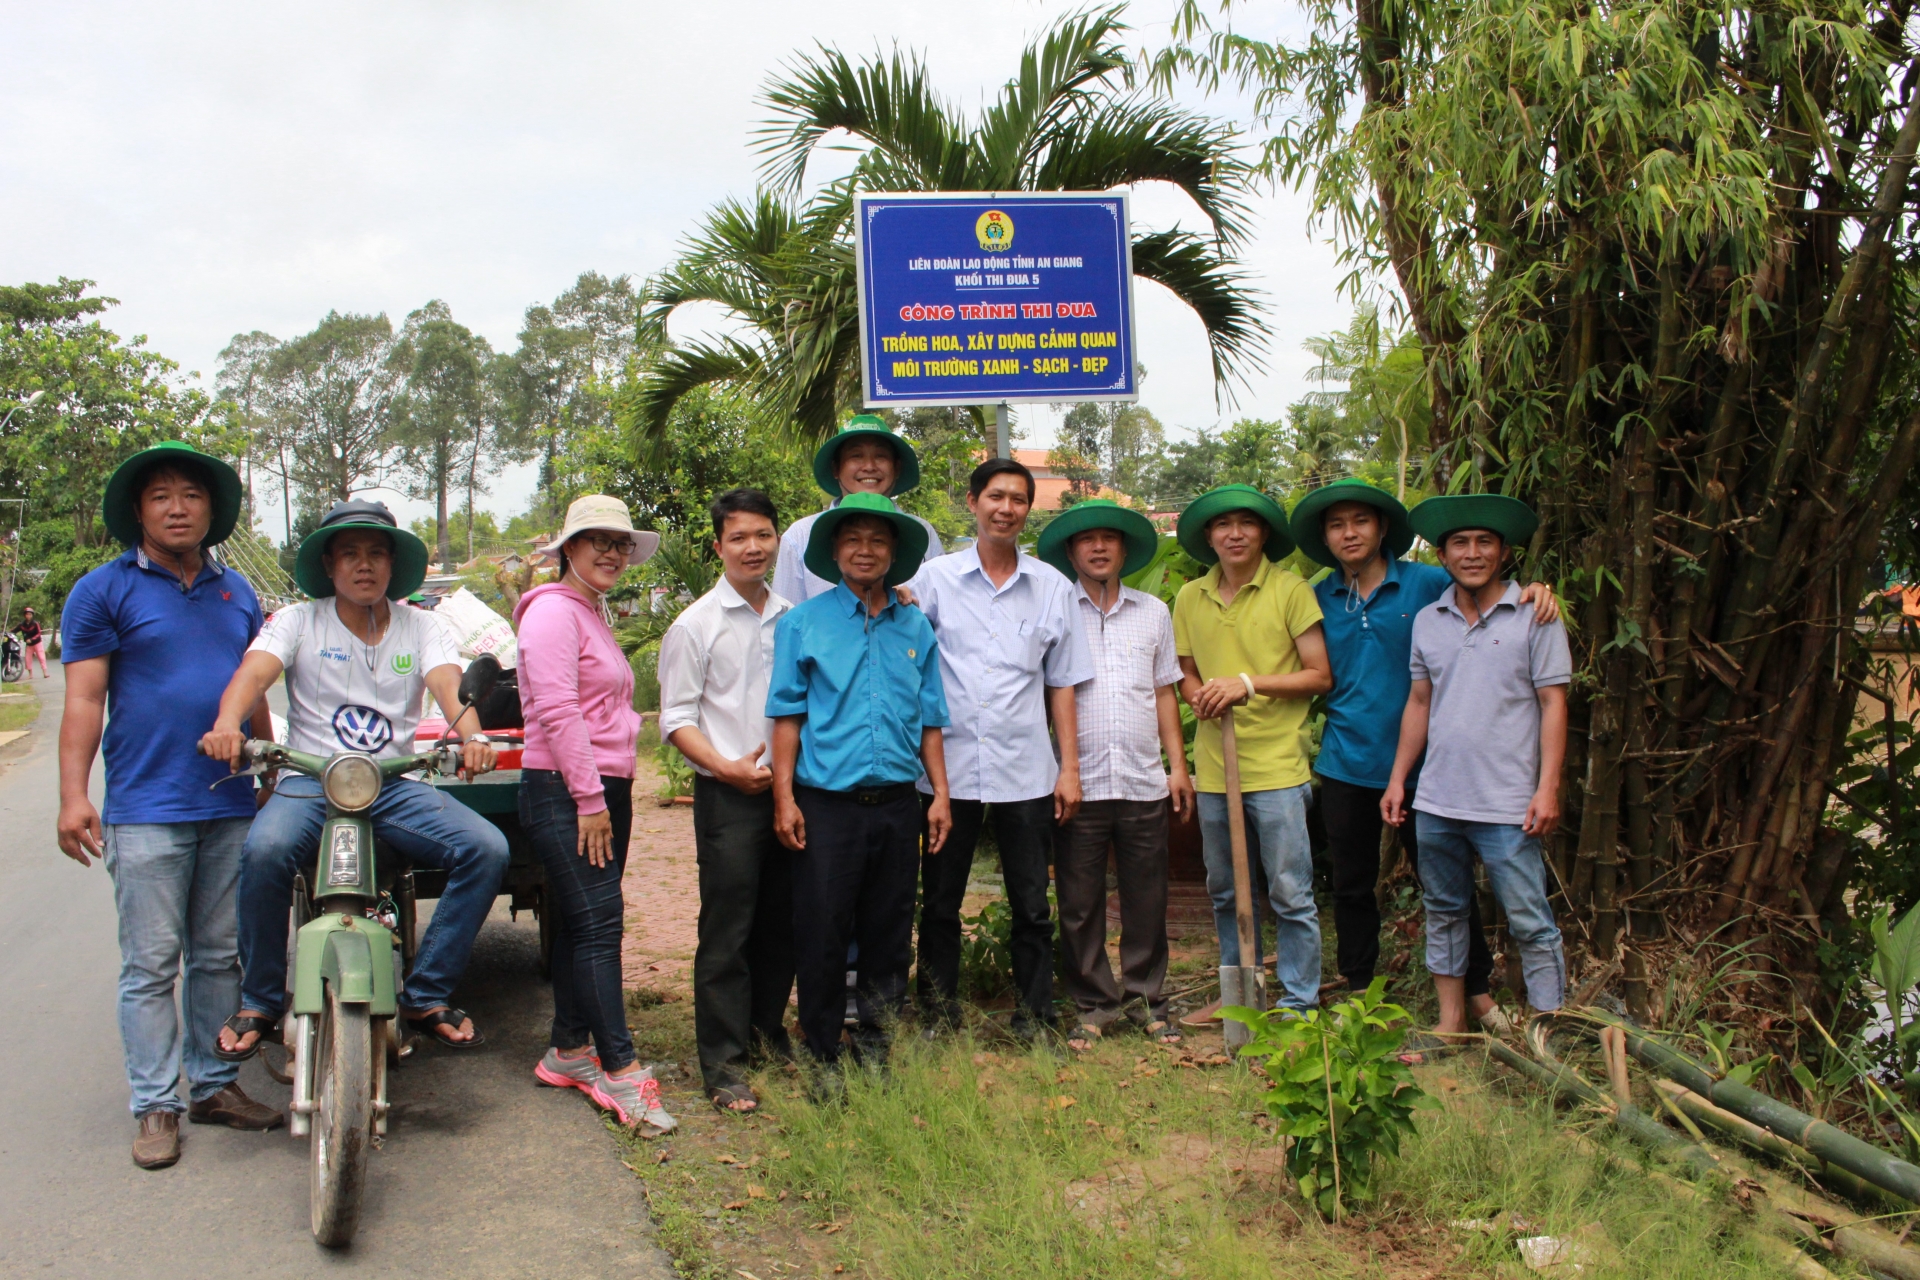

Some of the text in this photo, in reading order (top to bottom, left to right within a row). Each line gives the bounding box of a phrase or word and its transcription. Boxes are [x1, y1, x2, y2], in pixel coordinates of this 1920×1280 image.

[909, 255, 1082, 271] LIÊN ĐOÀN LAO ĐỘNG TỈNH AN GIANG
[955, 271, 1039, 287] KHỐI THI ĐUA 5
[900, 301, 1097, 321] CÔNG TRÌNH THI ĐUA
[882, 328, 1116, 352] TRỒNG HOA, XÂY DỰNG CẢNH QUAN
[893, 358, 919, 377] MÔI
[923, 357, 978, 376] TRƯỜNG
[982, 359, 1019, 374] XANH
[1033, 358, 1069, 375] SẠCH
[1082, 357, 1108, 374] ĐẸP
